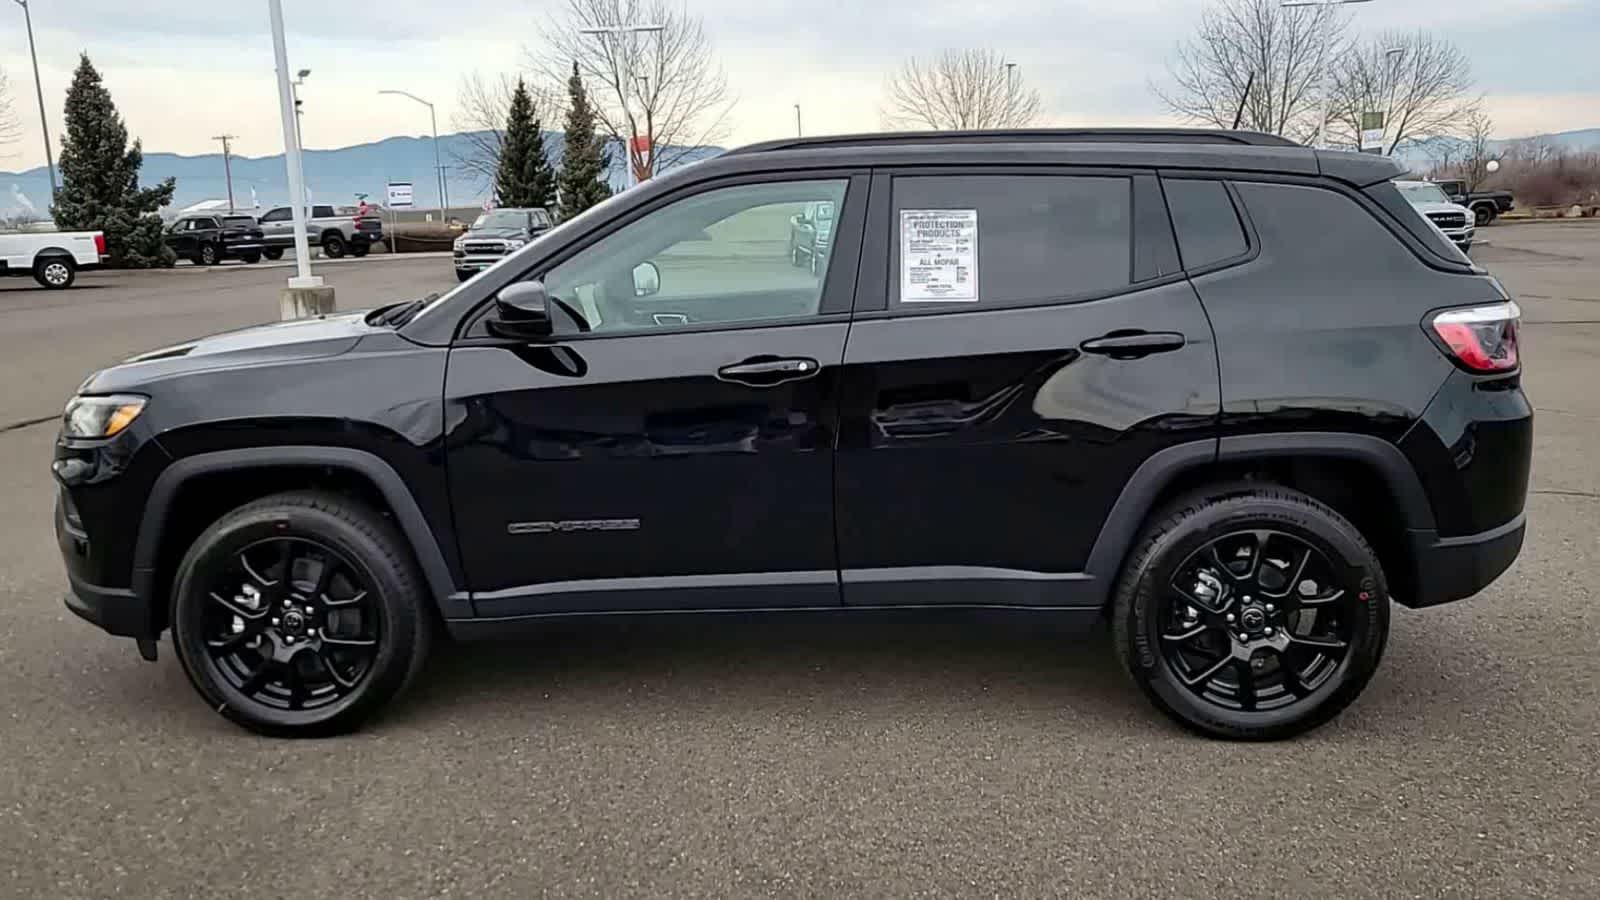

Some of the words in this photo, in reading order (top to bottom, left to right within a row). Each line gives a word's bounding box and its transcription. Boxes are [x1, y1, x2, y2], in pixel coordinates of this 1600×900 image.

[913, 220, 965, 229] PROTECTION
[917, 229, 961, 237] PRODUCTS
[919, 258, 932, 266] ALL
[934, 258, 959, 266] MOPAR
